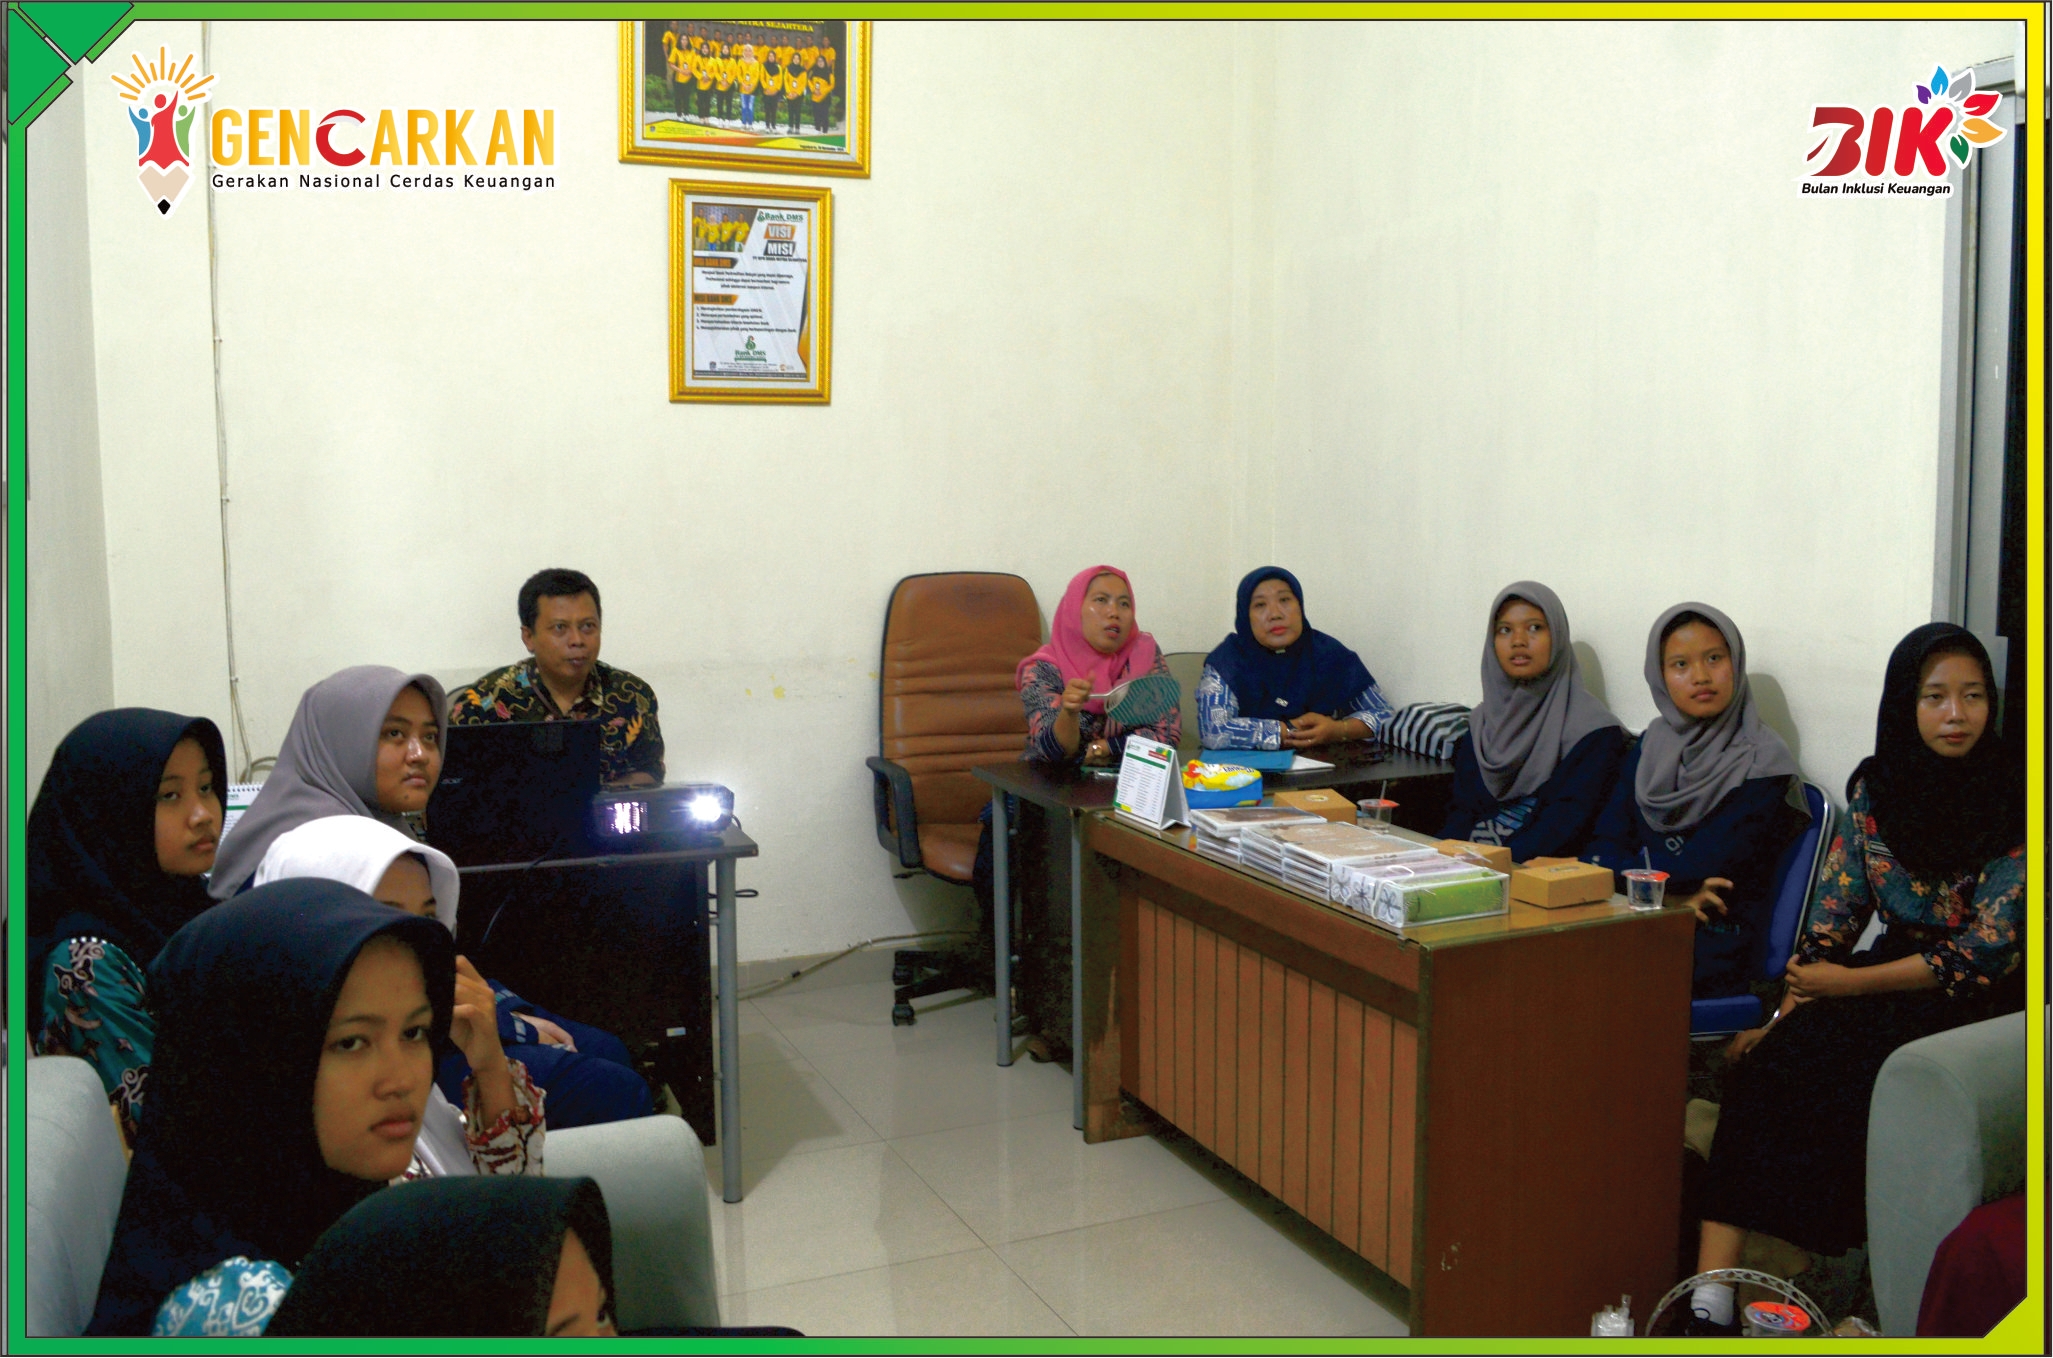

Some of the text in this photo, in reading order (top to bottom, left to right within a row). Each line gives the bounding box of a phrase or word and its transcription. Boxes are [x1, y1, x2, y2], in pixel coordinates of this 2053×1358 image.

[766, 20, 815, 33] SEJAHTERA
[765, 212, 804, 221] Bank DMS
[769, 225, 792, 239] VISI
[767, 242, 794, 256] MISI
